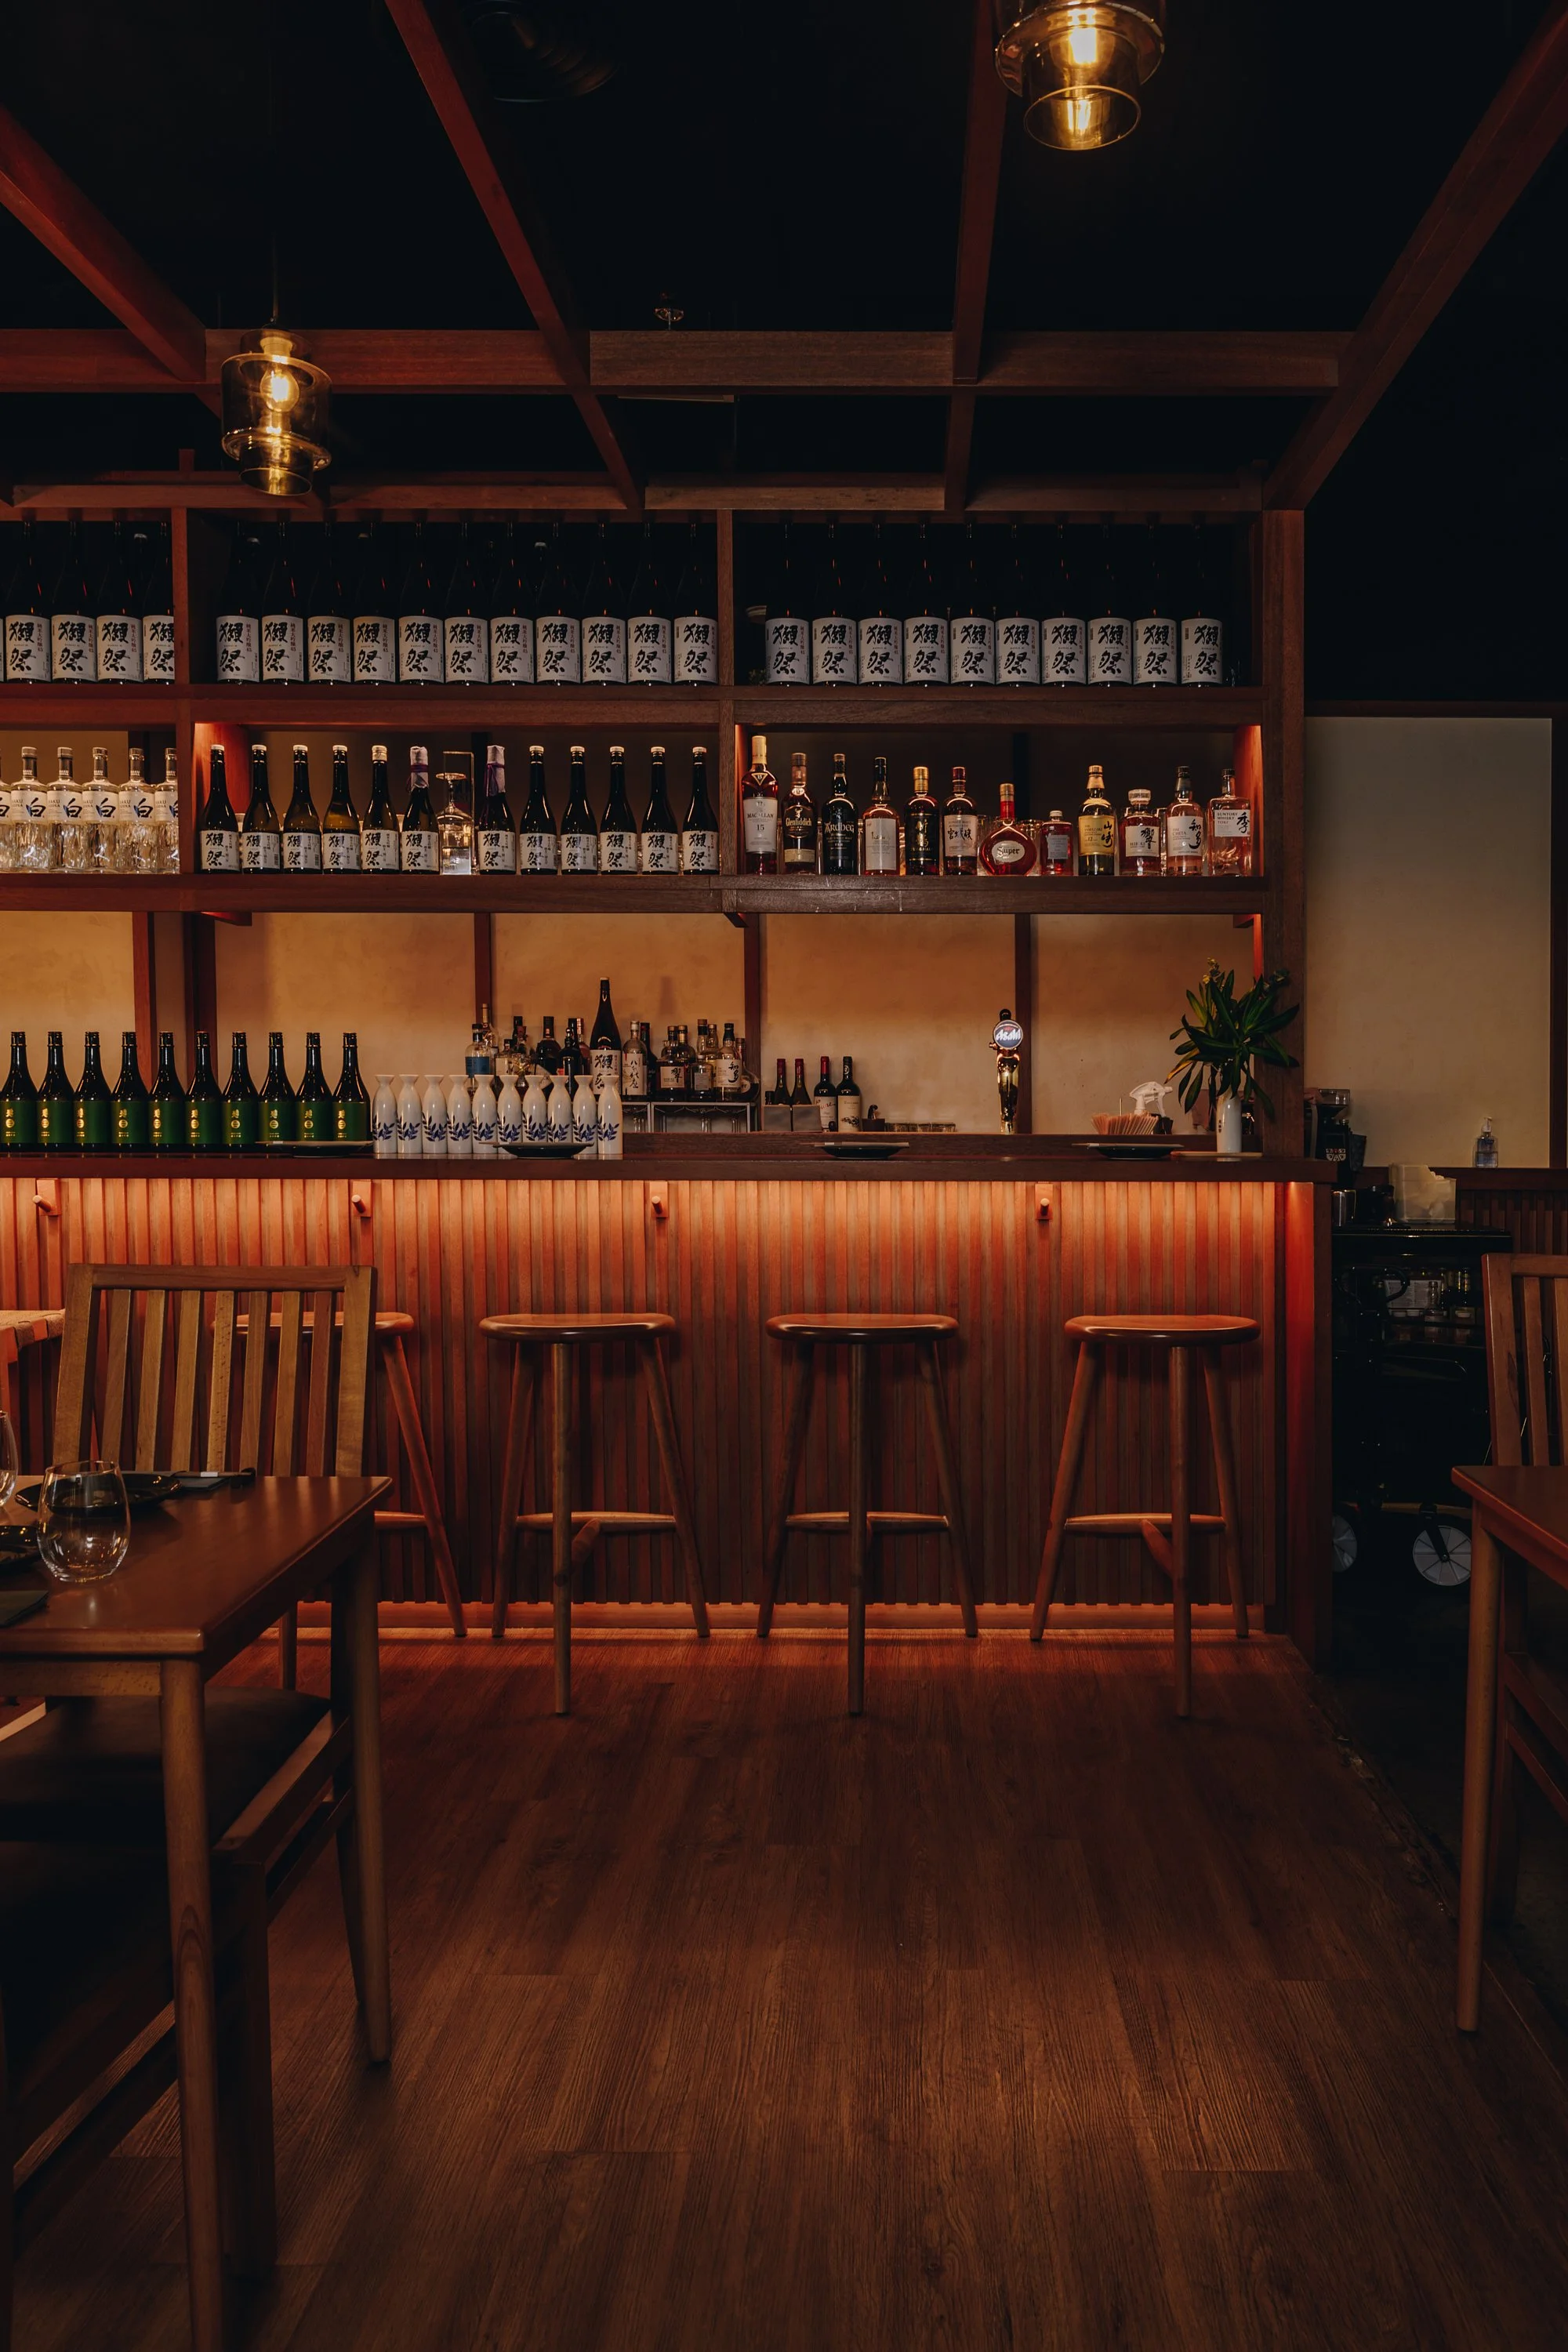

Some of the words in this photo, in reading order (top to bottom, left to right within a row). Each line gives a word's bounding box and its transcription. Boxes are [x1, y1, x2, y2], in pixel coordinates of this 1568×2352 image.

[9, 622, 36, 671] 獺祭
[58, 622, 89, 671] 獺祭
[103, 622, 130, 671] 獺祭
[220, 622, 245, 672] 獺祭
[263, 622, 289, 672] 獺祭
[311, 622, 337, 673] 獺祭
[353, 622, 379, 673] 獺祭
[405, 622, 432, 673] 獺祭
[449, 622, 476, 673] 獺祭
[495, 623, 521, 673] 獺祭
[543, 623, 569, 673] 獺祭
[589, 623, 615, 673] 獺祭
[634, 623, 661, 673] 獺祭
[684, 623, 710, 673] 獺祭
[773, 624, 800, 674] 獺祭
[821, 624, 848, 674] 獺祭
[866, 624, 894, 674] 獺祭
[913, 624, 940, 674] 獺祭
[960, 624, 988, 674] 獺祭
[1004, 624, 1031, 674] 獺祭
[1051, 624, 1079, 674] 獺祭
[1098, 624, 1126, 674] 獺祭
[1144, 625, 1171, 675] 獺祭
[1194, 625, 1220, 675] 獺祭
[26, 797, 45, 817] 白
[64, 798, 82, 818] 白
[96, 798, 116, 818] 白
[133, 798, 153, 818] 白
[786, 818, 812, 826] Glenfiddich
[996, 846, 1020, 856] Super
[1141, 828, 1156, 849] 響
[1189, 818, 1202, 849] 知多
